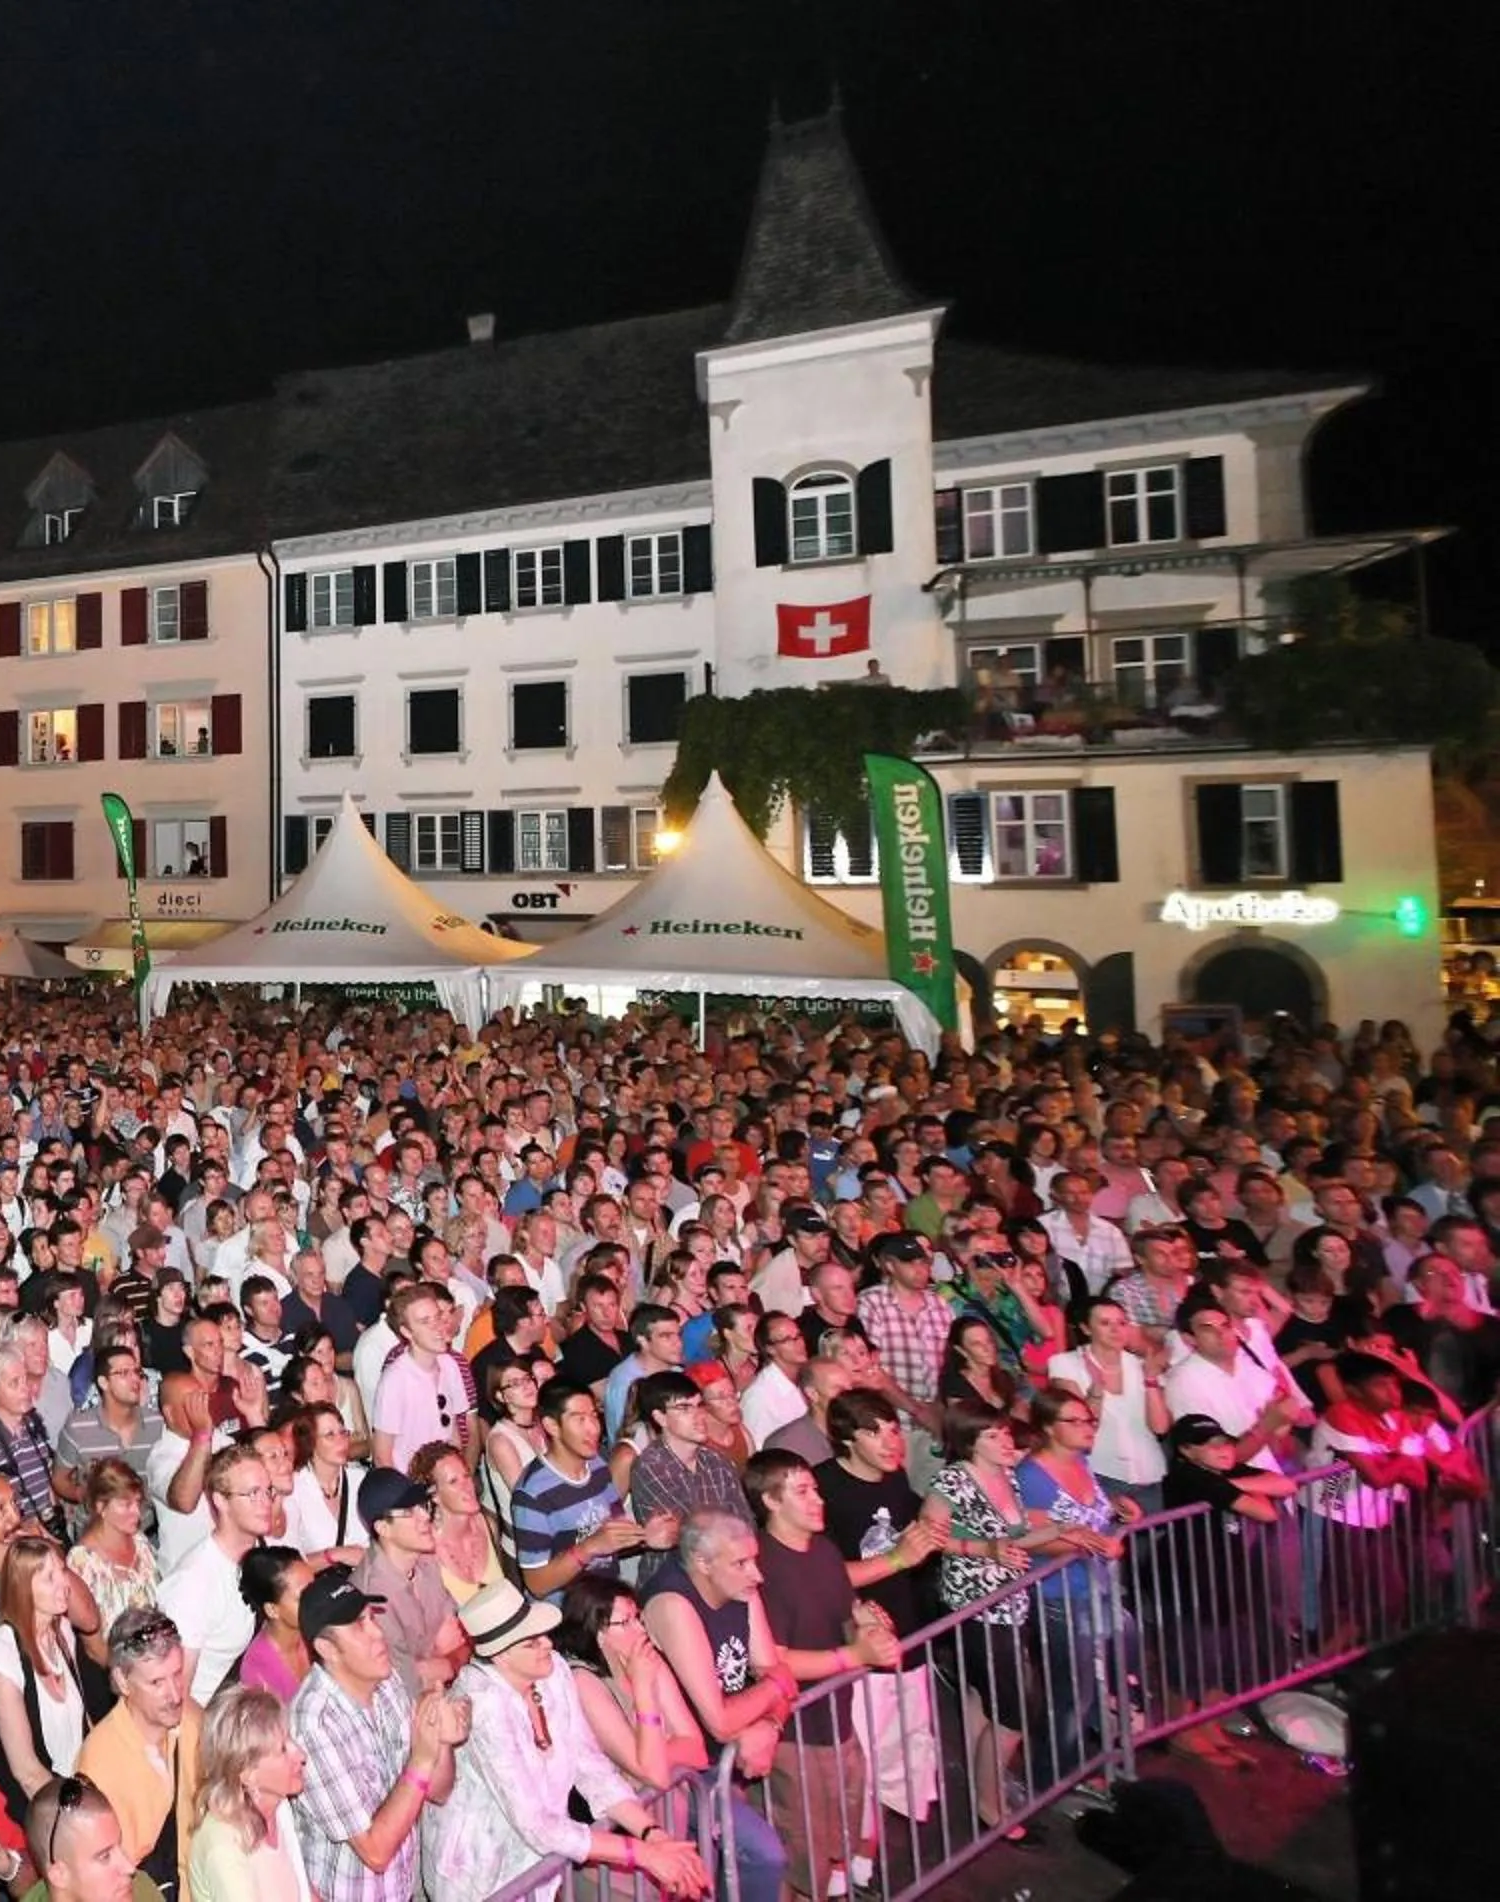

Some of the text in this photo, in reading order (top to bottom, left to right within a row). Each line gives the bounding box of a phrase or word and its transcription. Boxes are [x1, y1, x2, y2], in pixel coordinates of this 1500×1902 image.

[157, 892, 202, 906] dieci
[512, 893, 561, 908] OBT
[1161, 891, 1340, 931] Apotheke
[272, 917, 387, 935] Heineken
[650, 919, 804, 940] Heineken
